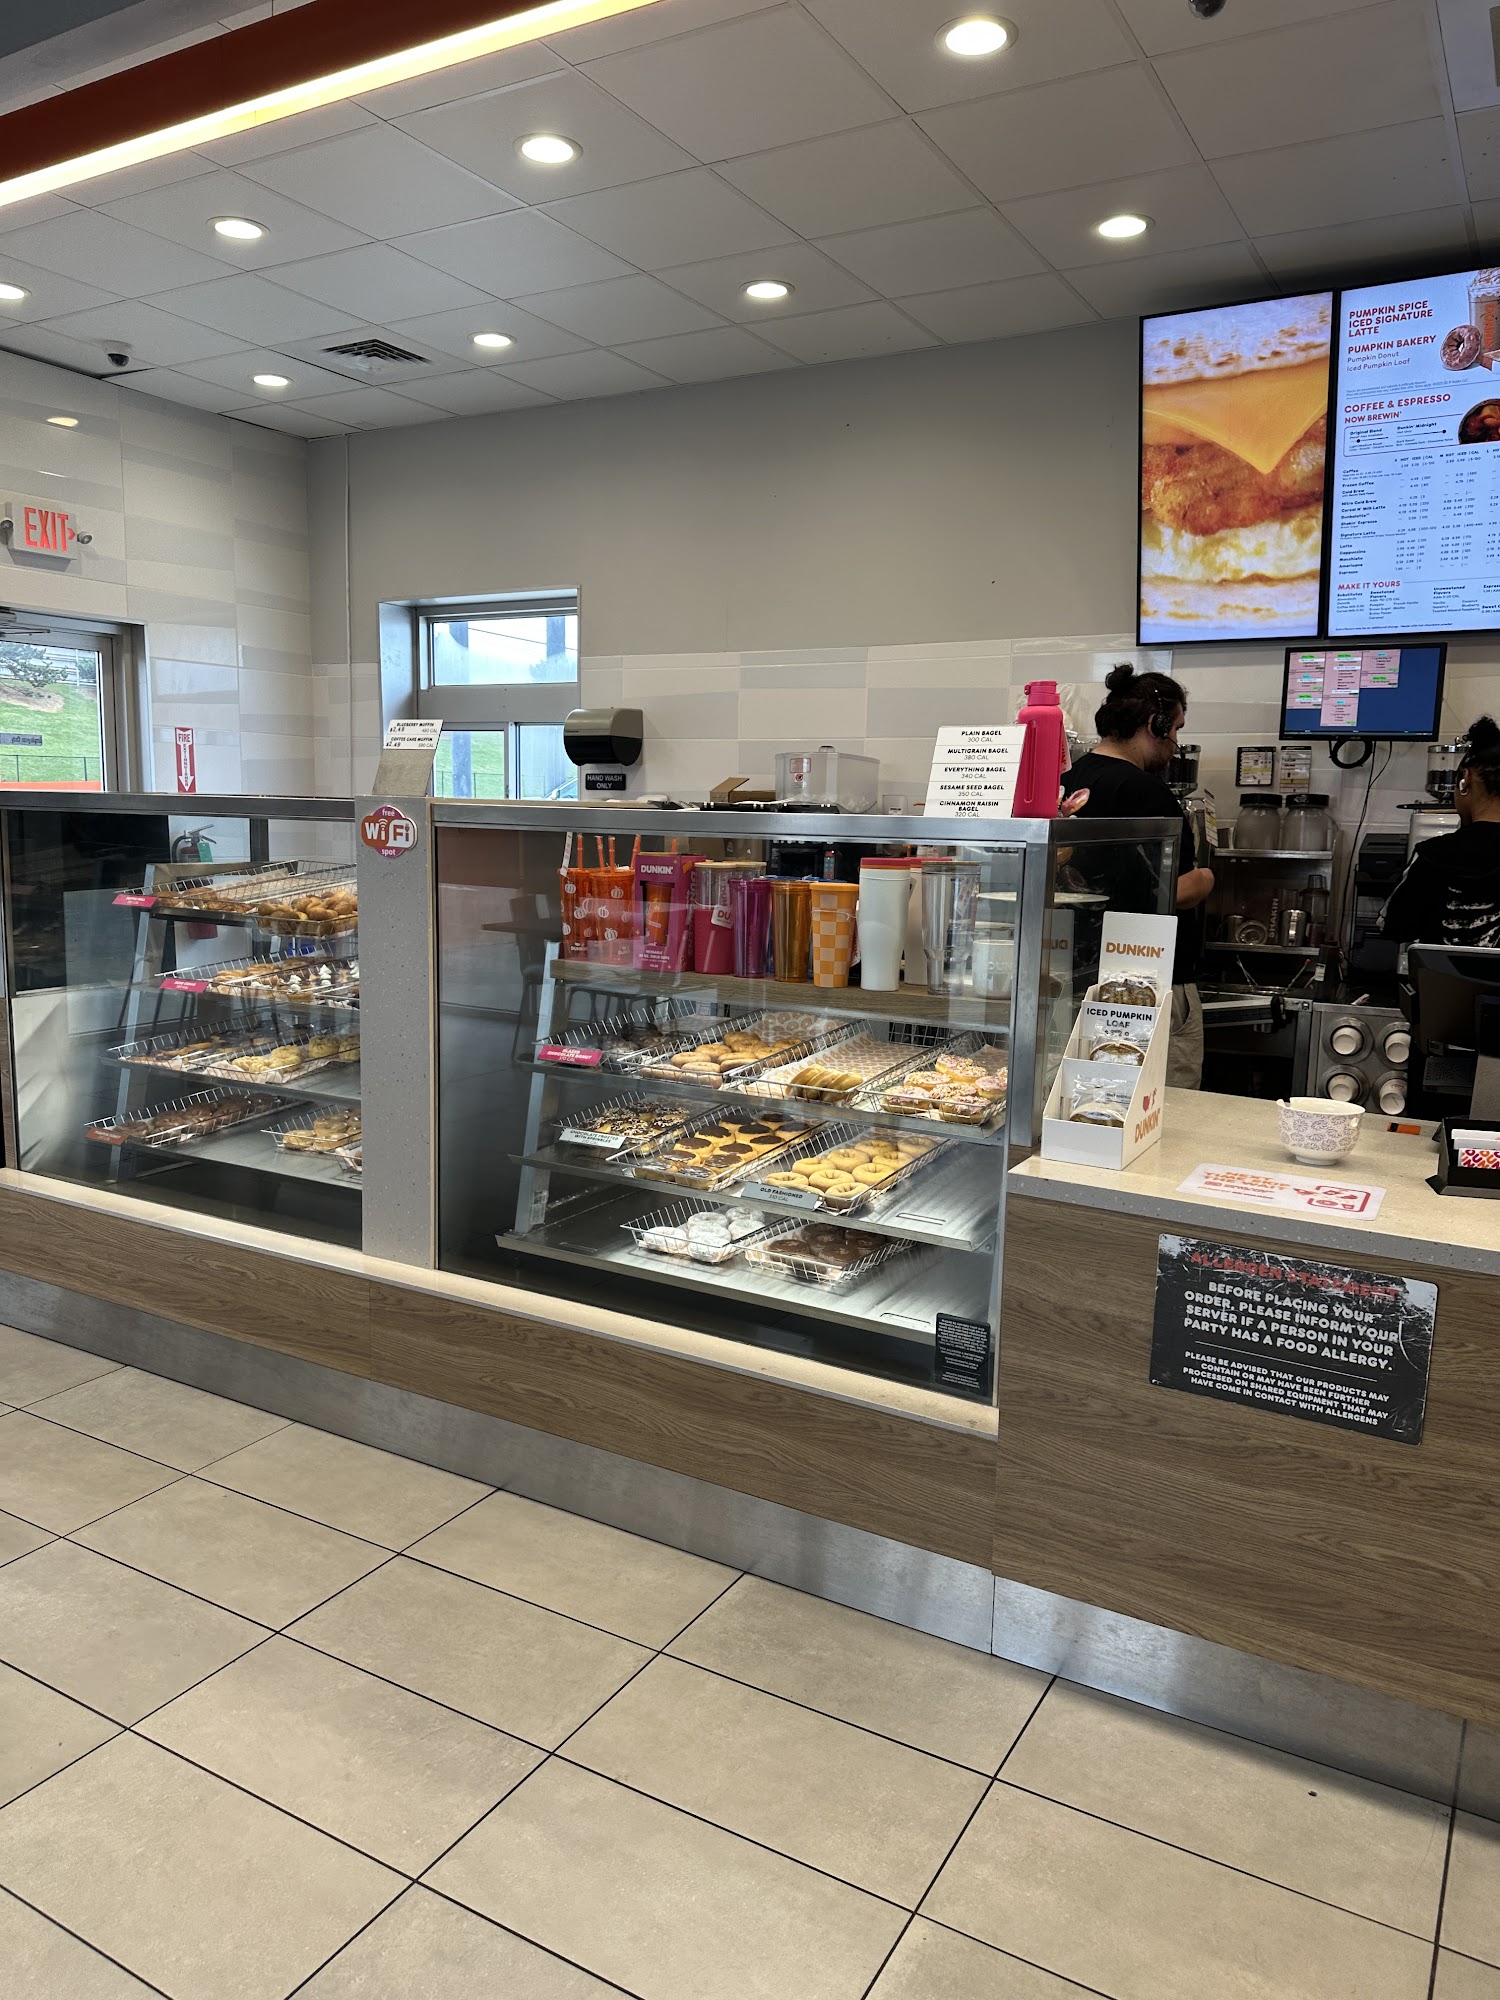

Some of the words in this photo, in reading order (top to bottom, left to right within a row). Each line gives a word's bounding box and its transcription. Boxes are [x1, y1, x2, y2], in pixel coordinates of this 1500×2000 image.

[1349, 319, 1372, 328] ICED
[1376, 309, 1433, 324] SIGNATURE
[1350, 306, 1395, 319] PUMPKIN
[1398, 301, 1428, 311] SPICE
[1349, 327, 1379, 337] LATTE
[1348, 342, 1393, 354] PUMPKIN
[1397, 335, 1436, 348] BAKERY
[1347, 354, 1376, 364] Pumpkin
[1378, 351, 1399, 360] Donut
[1363, 360, 1392, 370] Pumpkin
[1394, 358, 1410, 366] Loaf
[1344, 402, 1384, 413] COFFEE
[1388, 400, 1395, 408] &
[1398, 394, 1451, 407] ESPRESSO
[1345, 416, 1366, 424] NOW
[1368, 412, 1402, 421] BREWIN'
[24, 507, 68, 552] EXIT
[178, 734, 191, 742] FIRE
[382, 808, 395, 816] free
[382, 848, 396, 856] spot
[640, 865, 673, 875] DUNKIN'
[1106, 942, 1165, 958] DUNKIN'
[1087, 1008, 1108, 1016] ICED
[1110, 1010, 1152, 1021] PUMPKIN
[1106, 1020, 1130, 1028] LOAF
[772, 1190, 803, 1198] FASHIONED
[1190, 1251, 1282, 1281] ALLERGEN
[1287, 1266, 1400, 1301] STATEMENT
[1209, 1282, 1261, 1301] BEFORE
[1265, 1293, 1328, 1315] PLACING
[1333, 1305, 1374, 1324] YOUR
[1184, 1290, 1235, 1311] ORDER,
[1240, 1301, 1291, 1321] PLEASE
[1295, 1313, 1352, 1333] INFORM
[1356, 1326, 1399, 1343] YOUR
[1186, 1305, 1237, 1324] SERVER
[1241, 1316, 1253, 1327] IF
[1257, 1320, 1267, 1329] A
[1271, 1323, 1328, 1343] PERSON
[1332, 1335, 1348, 1346] IN
[1353, 1339, 1393, 1357] YOUR
[1184, 1318, 1228, 1335] PARTY
[1231, 1328, 1260, 1344] HAS
[1263, 1335, 1272, 1345] A
[1276, 1337, 1317, 1355] FOOD
[1321, 1347, 1393, 1371] ALLERGY.
[1185, 1351, 1216, 1363] PLEASE
[1218, 1358, 1229, 1366] BE
[1231, 1360, 1267, 1375] ADVISED
[1270, 1368, 1293, 1380] THAT
[1295, 1375, 1314, 1386] OUR
[1317, 1379, 1366, 1398] PRODUCTS
[1369, 1392, 1389, 1403] MAY
[1201, 1363, 1240, 1378] CONTAIN
[1242, 1372, 1255, 1380] OR
[1257, 1375, 1276, 1385] MAY
[1278, 1379, 1301, 1391] HAVE
[1303, 1385, 1326, 1397] BEEN
[1328, 1391, 1370, 1406] FURTHER
[1183, 1367, 1233, 1385] PROCESSED
[1235, 1378, 1248, 1387] ON
[1250, 1381, 1285, 1396] SHARED
[1287, 1390, 1340, 1409] EQUIPMENT
[1342, 1402, 1366, 1414] THAT
[1368, 1408, 1388, 1419] MAY
[1191, 1377, 1213, 1389] HAVE
[1216, 1383, 1241, 1395] COME
[1243, 1388, 1252, 1397] IN
[1254, 1391, 1296, 1407] CONTACT
[1299, 1401, 1324, 1413] WITH
[1326, 1408, 1378, 1426] ALLERGENS
